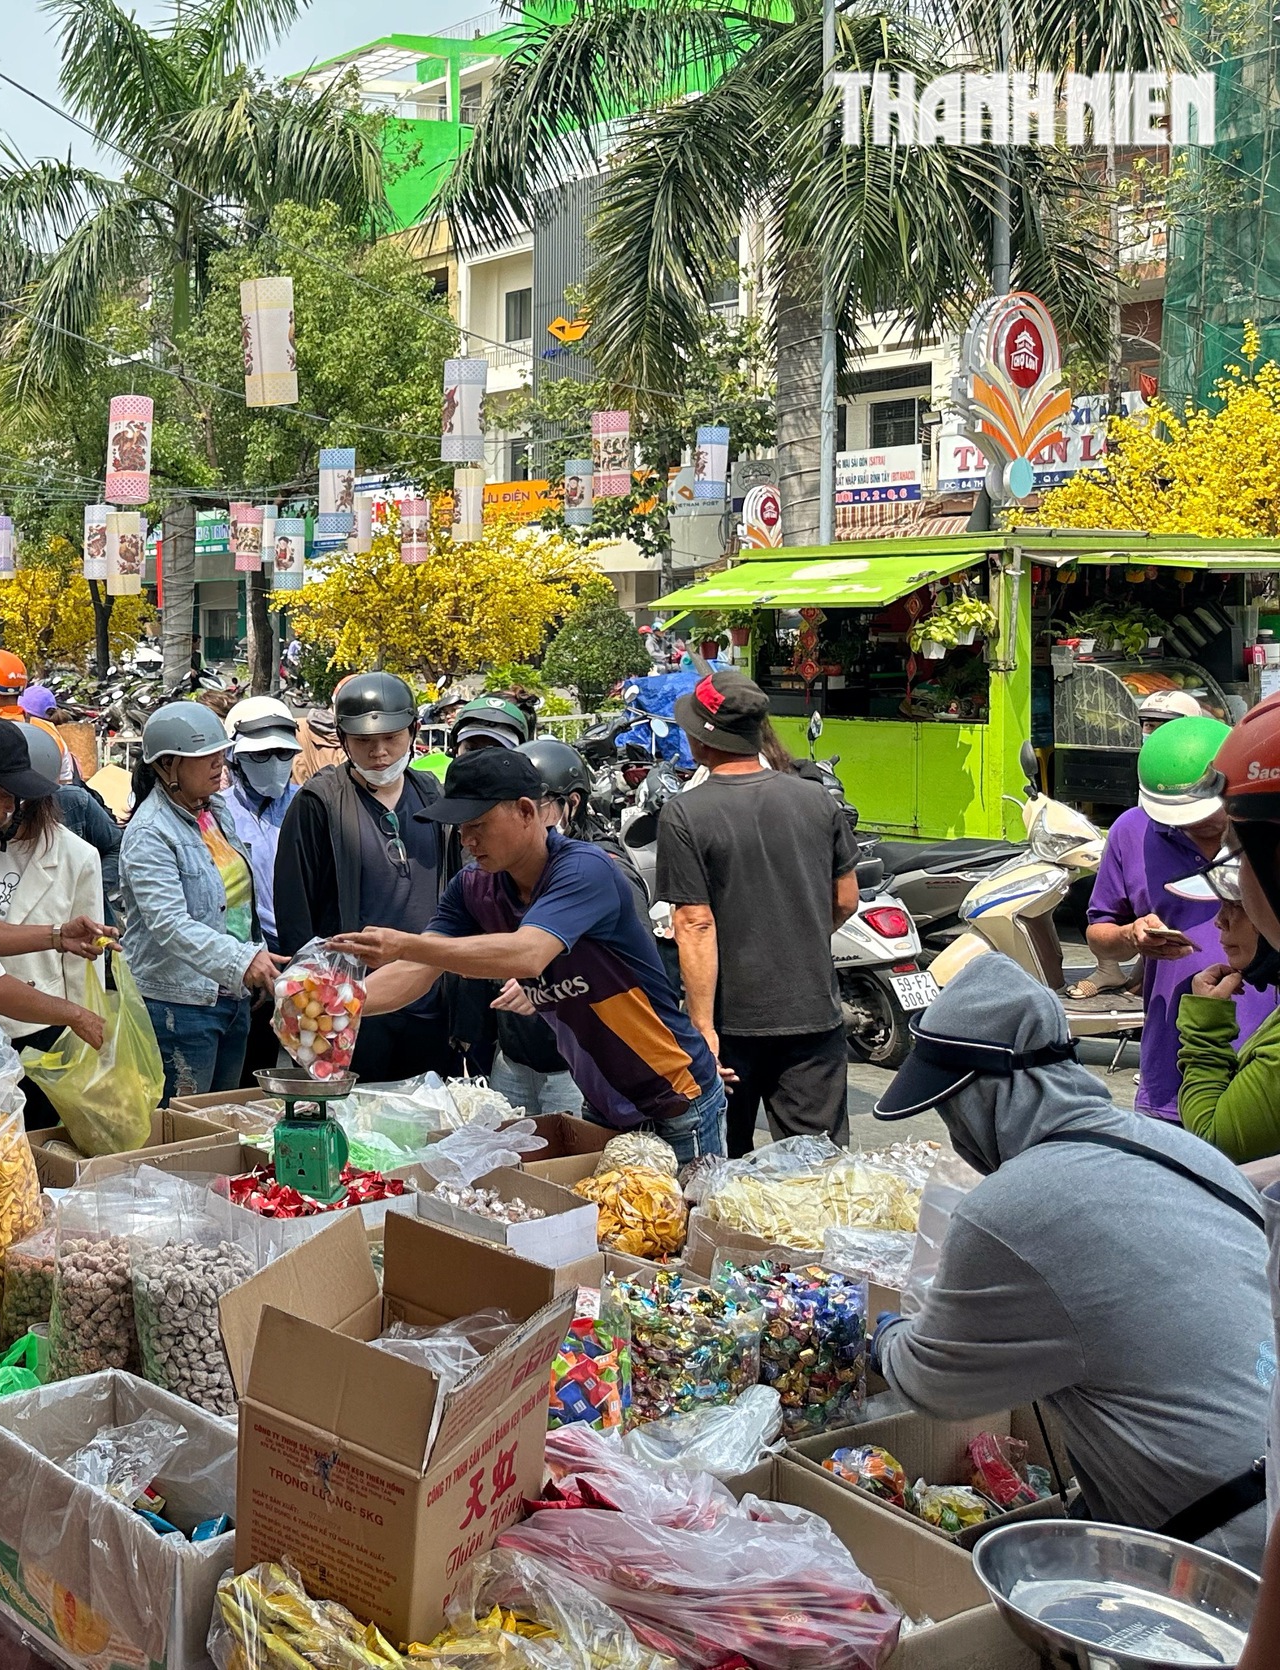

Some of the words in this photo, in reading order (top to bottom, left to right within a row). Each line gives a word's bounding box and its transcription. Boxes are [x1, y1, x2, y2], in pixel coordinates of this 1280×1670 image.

[896, 973, 931, 992] 59-F2
[268, 1466, 308, 1494] TRỌNG
[359, 1507, 384, 1526] 5KG
